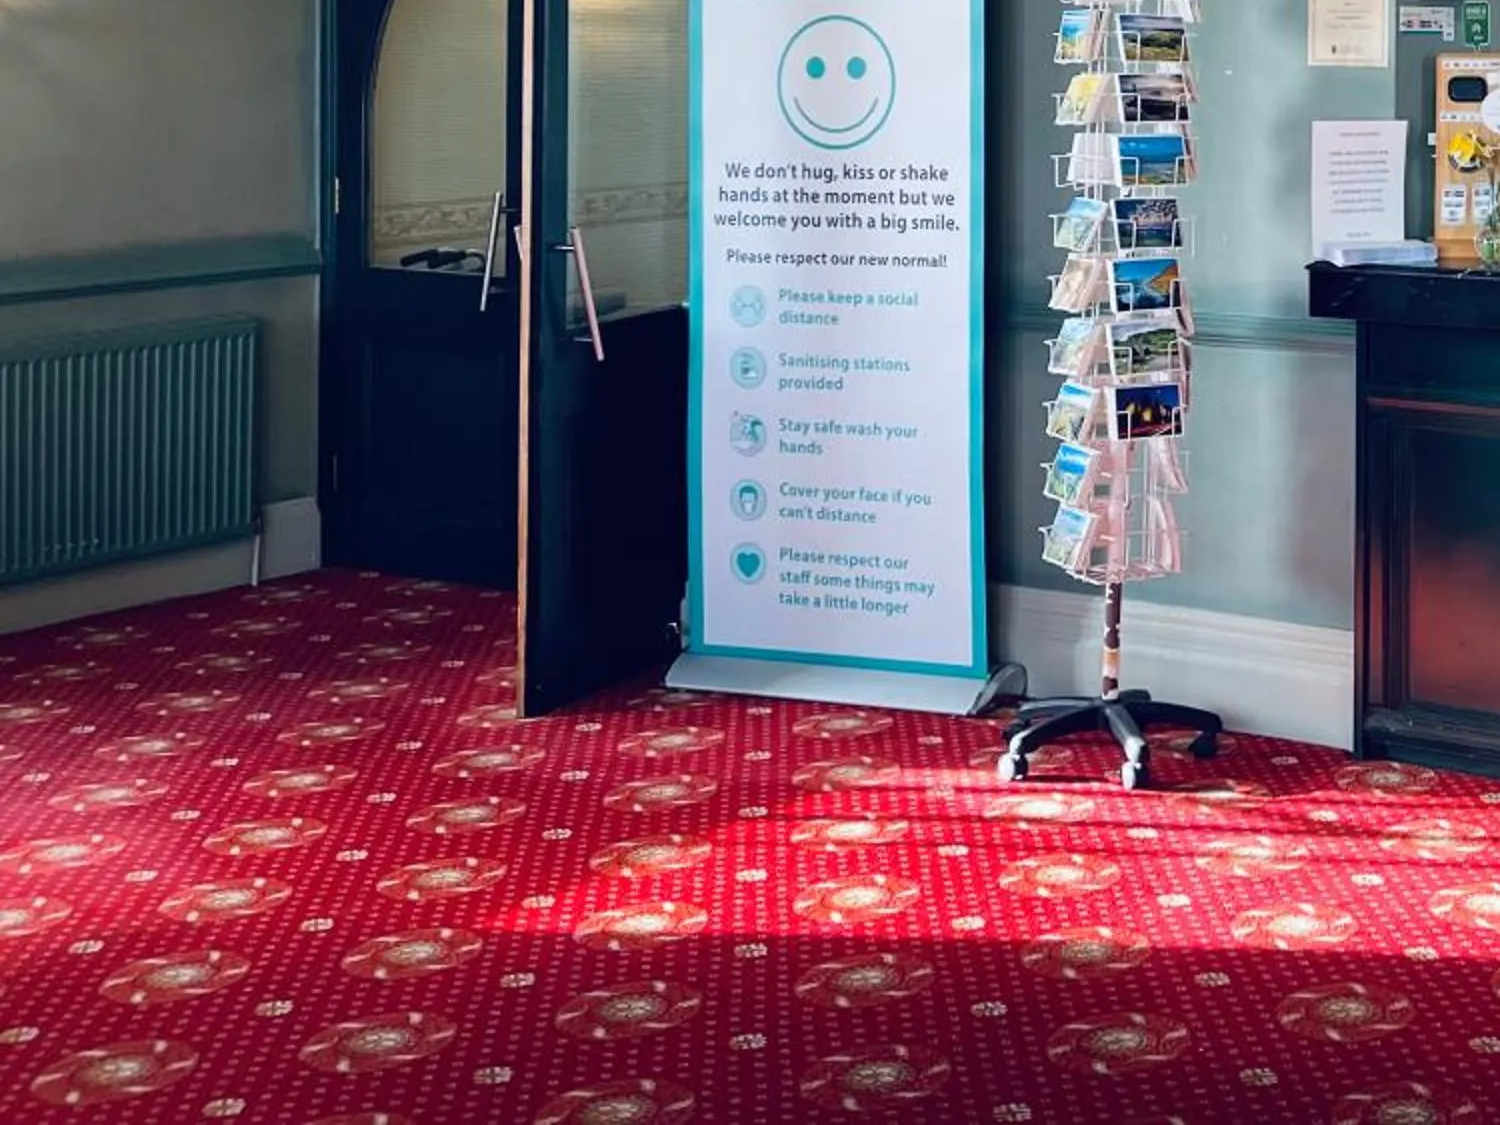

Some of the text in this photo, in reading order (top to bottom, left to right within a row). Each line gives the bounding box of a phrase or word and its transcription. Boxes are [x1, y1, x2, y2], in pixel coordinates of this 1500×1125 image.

[725, 163, 949, 183] We don't hug, kiss or shake
[719, 187, 955, 206] hands at the moment but we
[714, 211, 960, 233] welcome you with a big smile.
[726, 249, 947, 268] Please respect our new normal!
[779, 288, 919, 306] Please keep a social
[779, 310, 839, 325] distance
[779, 352, 910, 372] Sanitising stations
[779, 376, 843, 391] provided
[779, 418, 918, 440] Stay safe wash your
[779, 440, 823, 455] hands
[779, 482, 931, 507] Cover your face if you
[779, 506, 877, 523] can't distance
[779, 547, 909, 569] Please respect our
[779, 570, 934, 597] staff some things may
[779, 592, 909, 616] take a little longer
